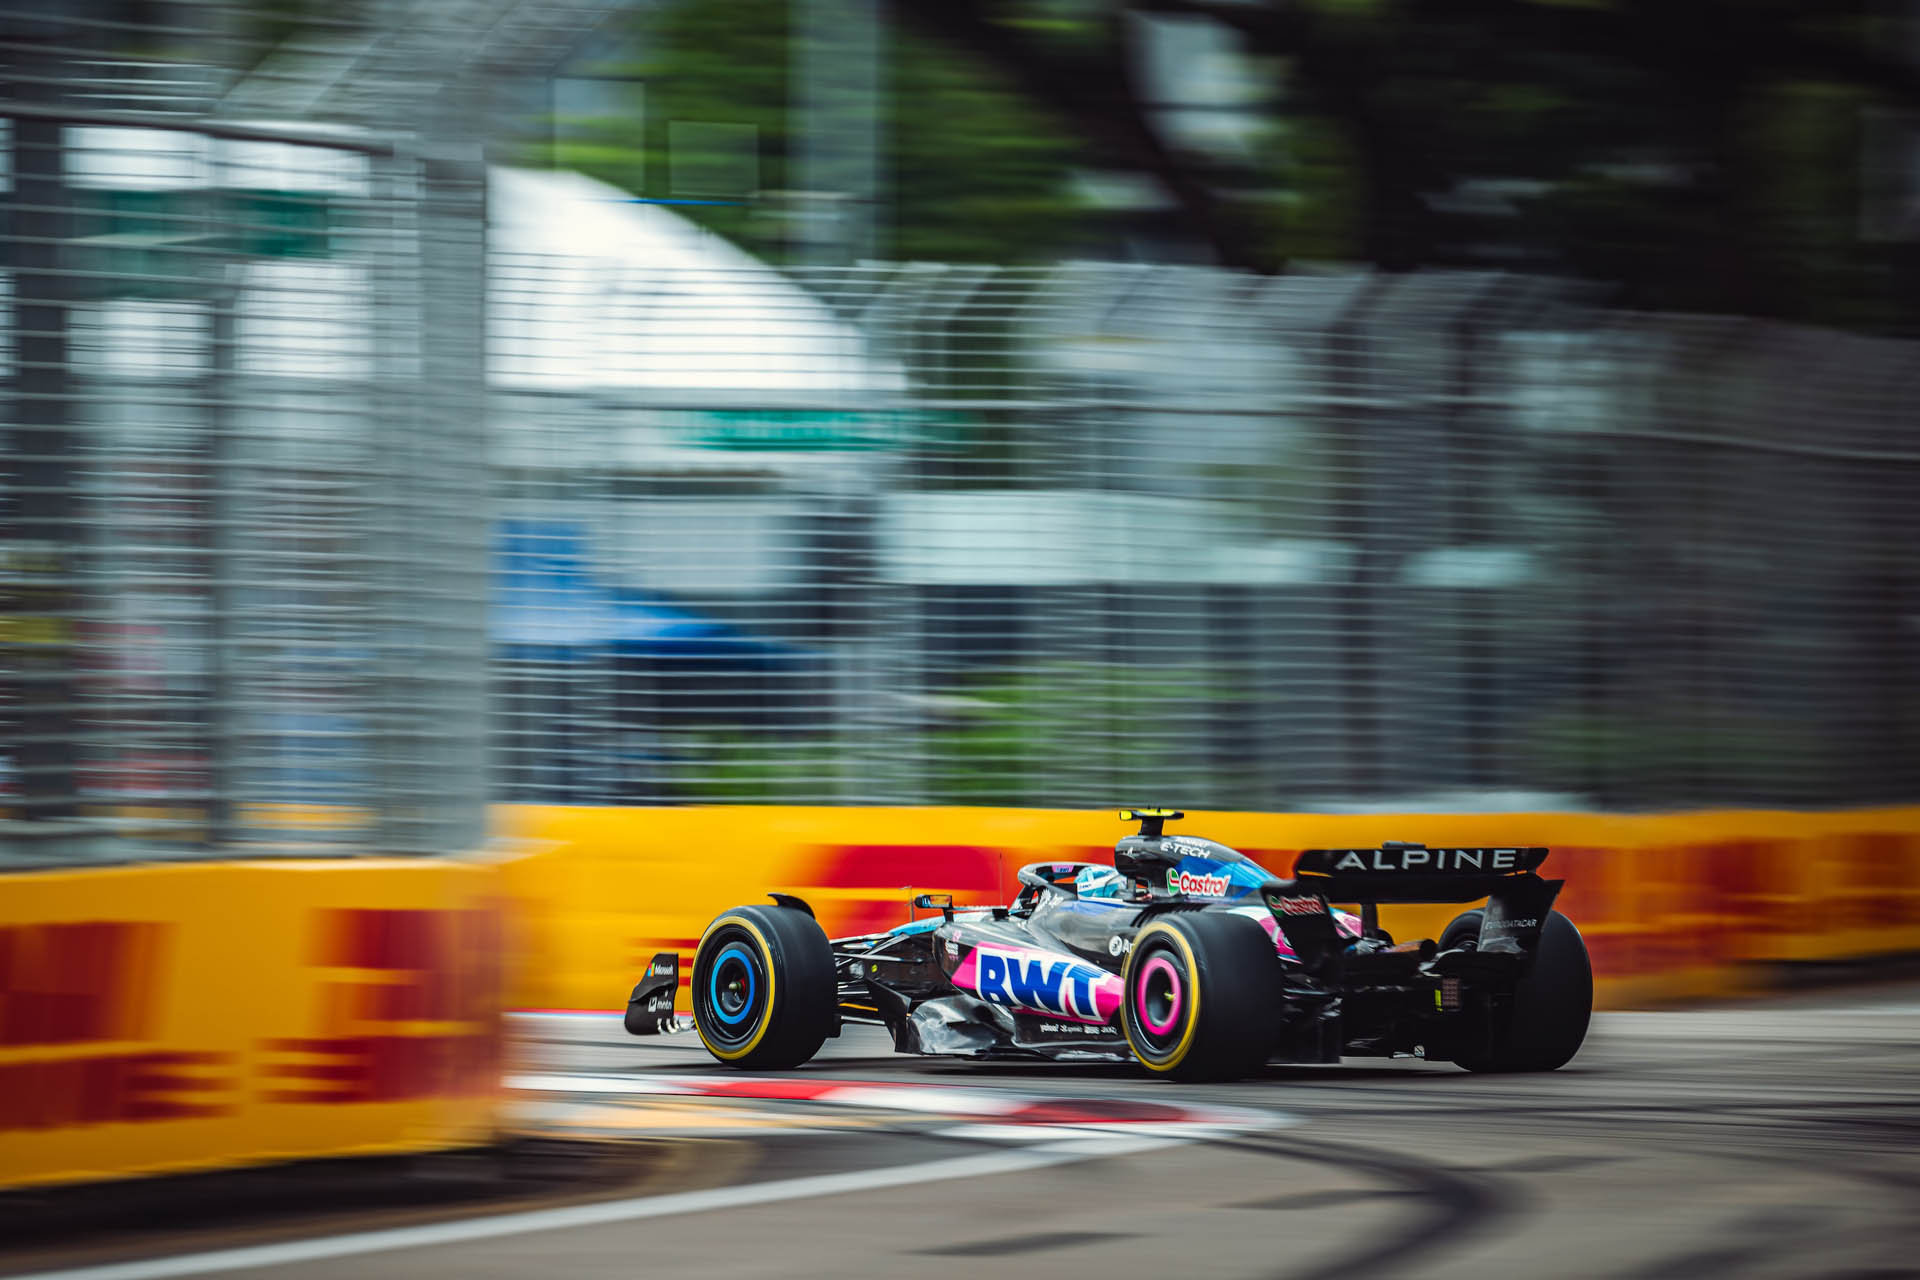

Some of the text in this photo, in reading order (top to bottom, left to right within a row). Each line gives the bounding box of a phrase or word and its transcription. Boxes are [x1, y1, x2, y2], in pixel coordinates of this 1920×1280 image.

[1335, 850, 1516, 870] ALPINE
[1179, 871, 1230, 896] Castrol
[979, 953, 1102, 1017] BWT
